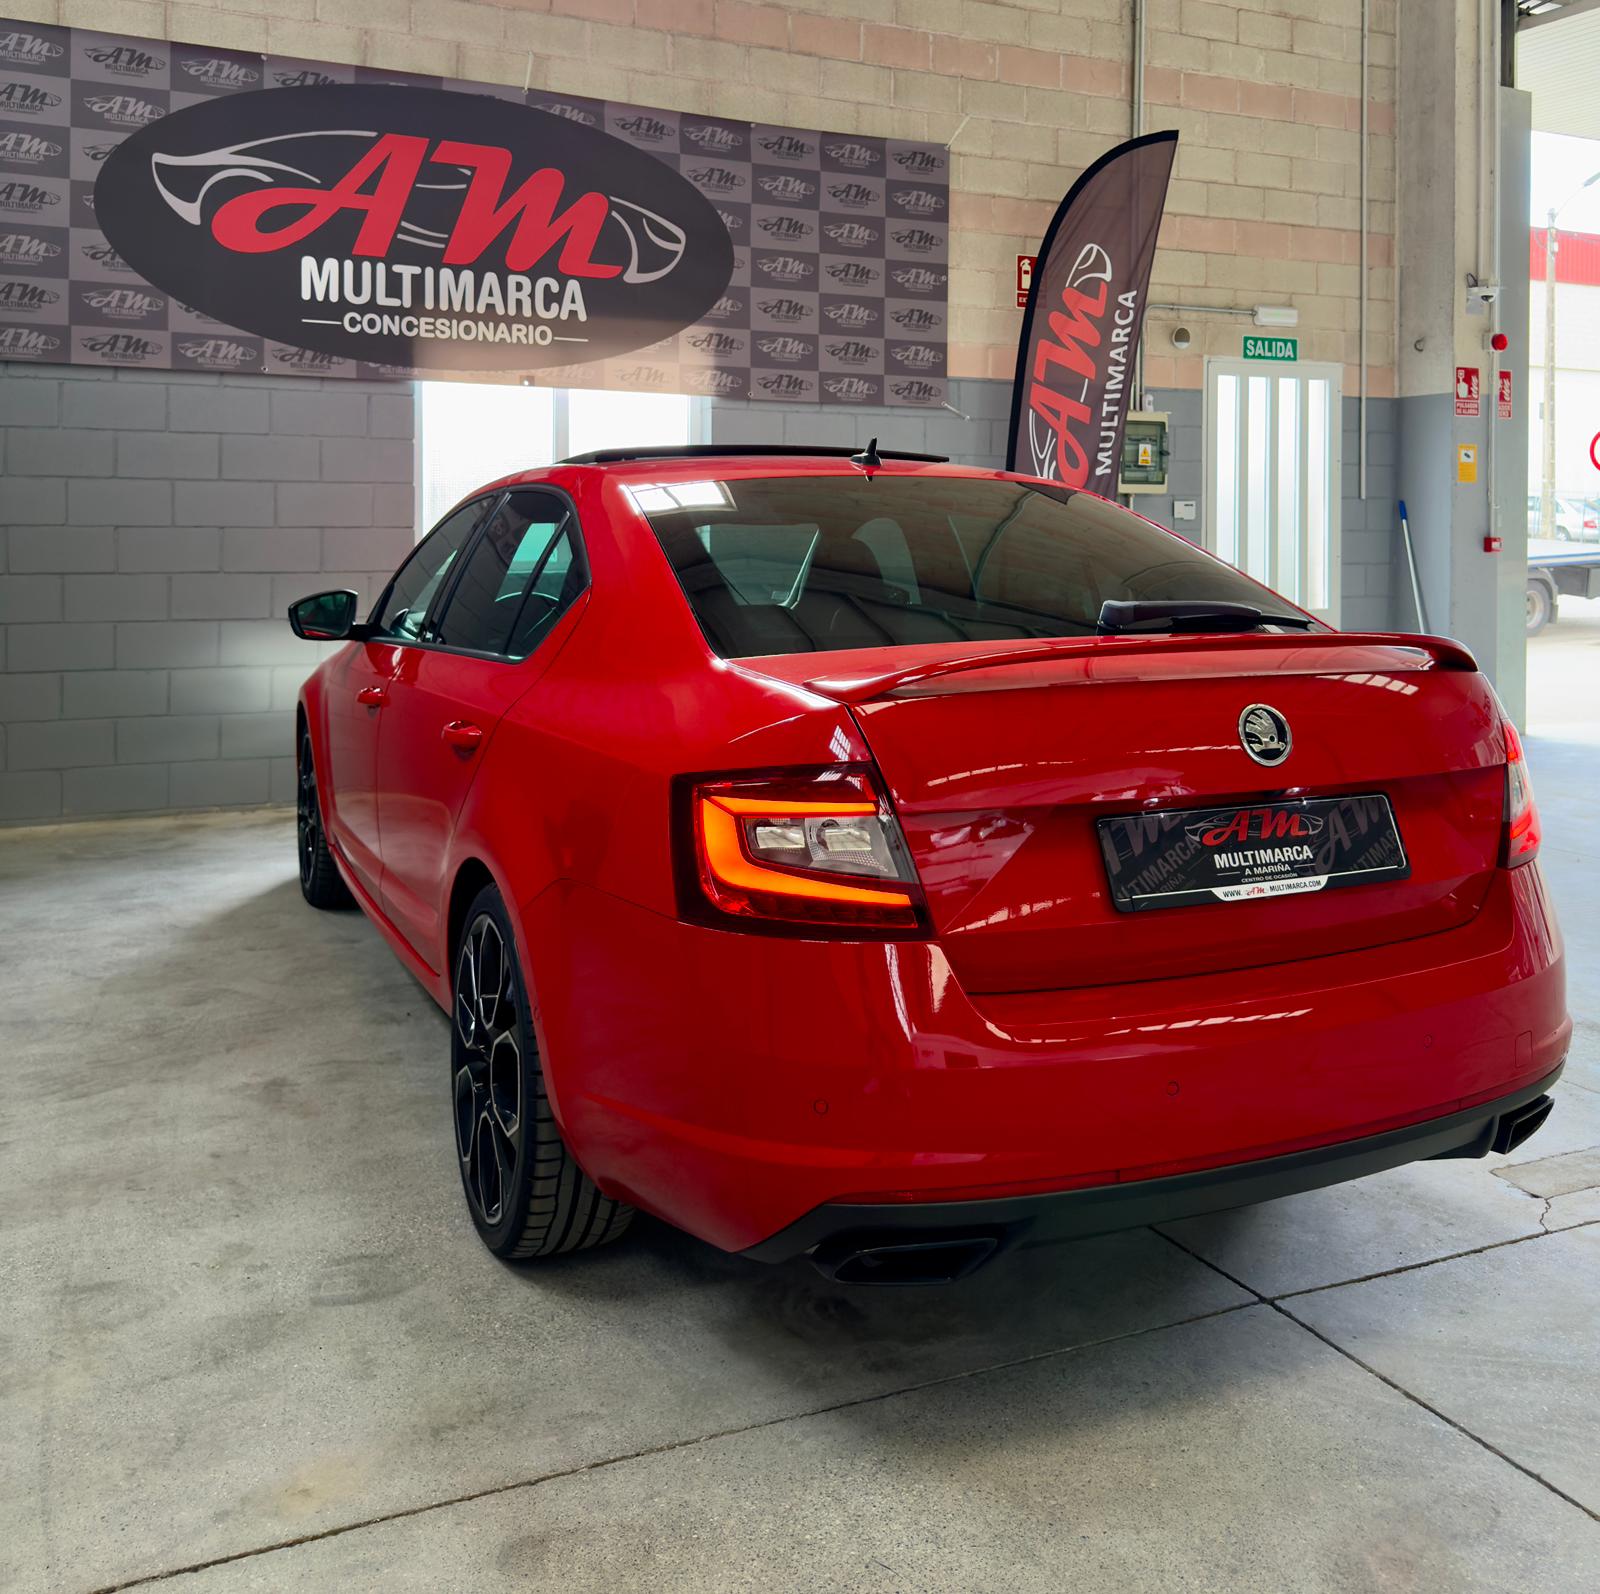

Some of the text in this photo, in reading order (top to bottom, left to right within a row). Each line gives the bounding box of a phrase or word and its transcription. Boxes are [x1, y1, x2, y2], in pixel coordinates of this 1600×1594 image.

[300, 255, 588, 322] MULTIMARCA
[342, 312, 553, 346] CONCESIONARIO
[1246, 340, 1294, 358] SALIDA
[1095, 289, 1137, 477] MULTIMARCA
[1213, 845, 1314, 869] MULTIMARCA
[1245, 863, 1291, 876] A MARIÑA
[1269, 879, 1322, 892] MULTIMARCA.COM
